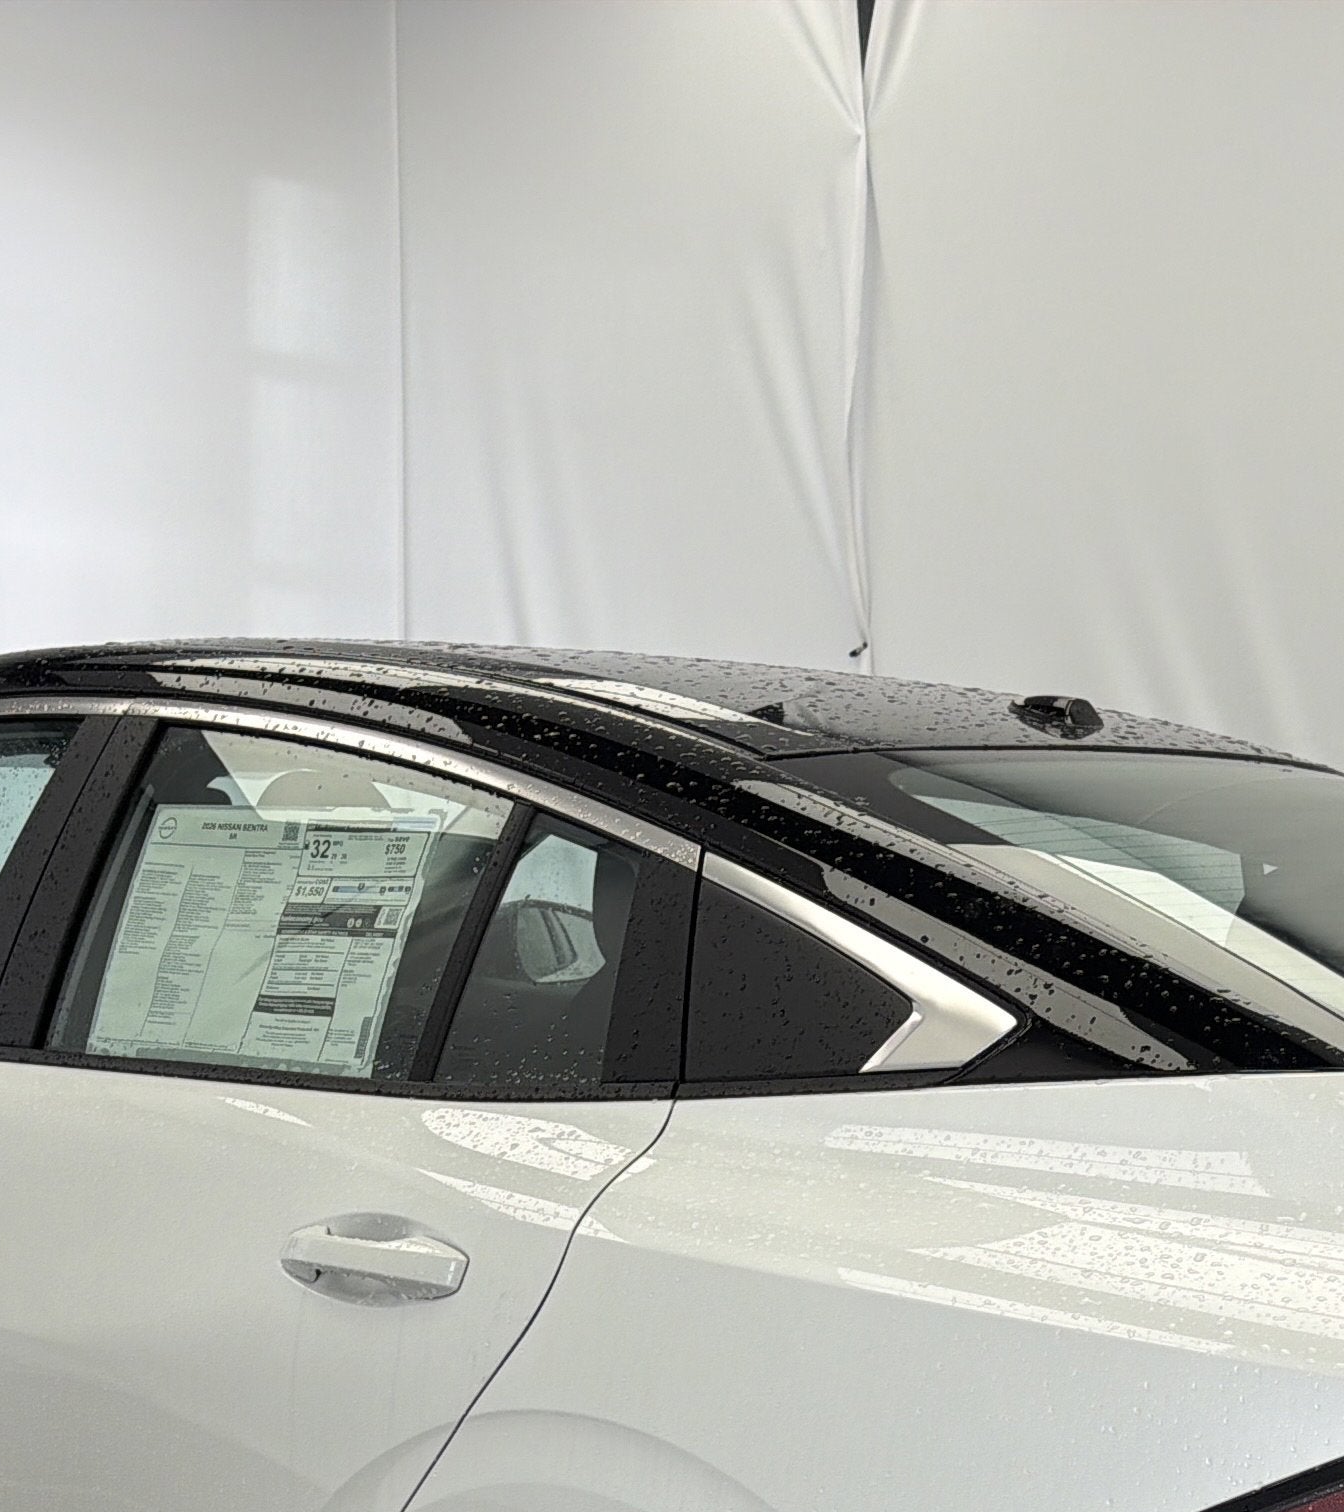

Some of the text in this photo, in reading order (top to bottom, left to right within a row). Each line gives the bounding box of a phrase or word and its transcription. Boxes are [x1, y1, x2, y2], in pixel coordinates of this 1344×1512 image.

[217, 822, 242, 832] NISSAN
[242, 823, 268, 833] SENTRA
[310, 839, 332, 859] 32
[295, 886, 325, 898] $1,550
